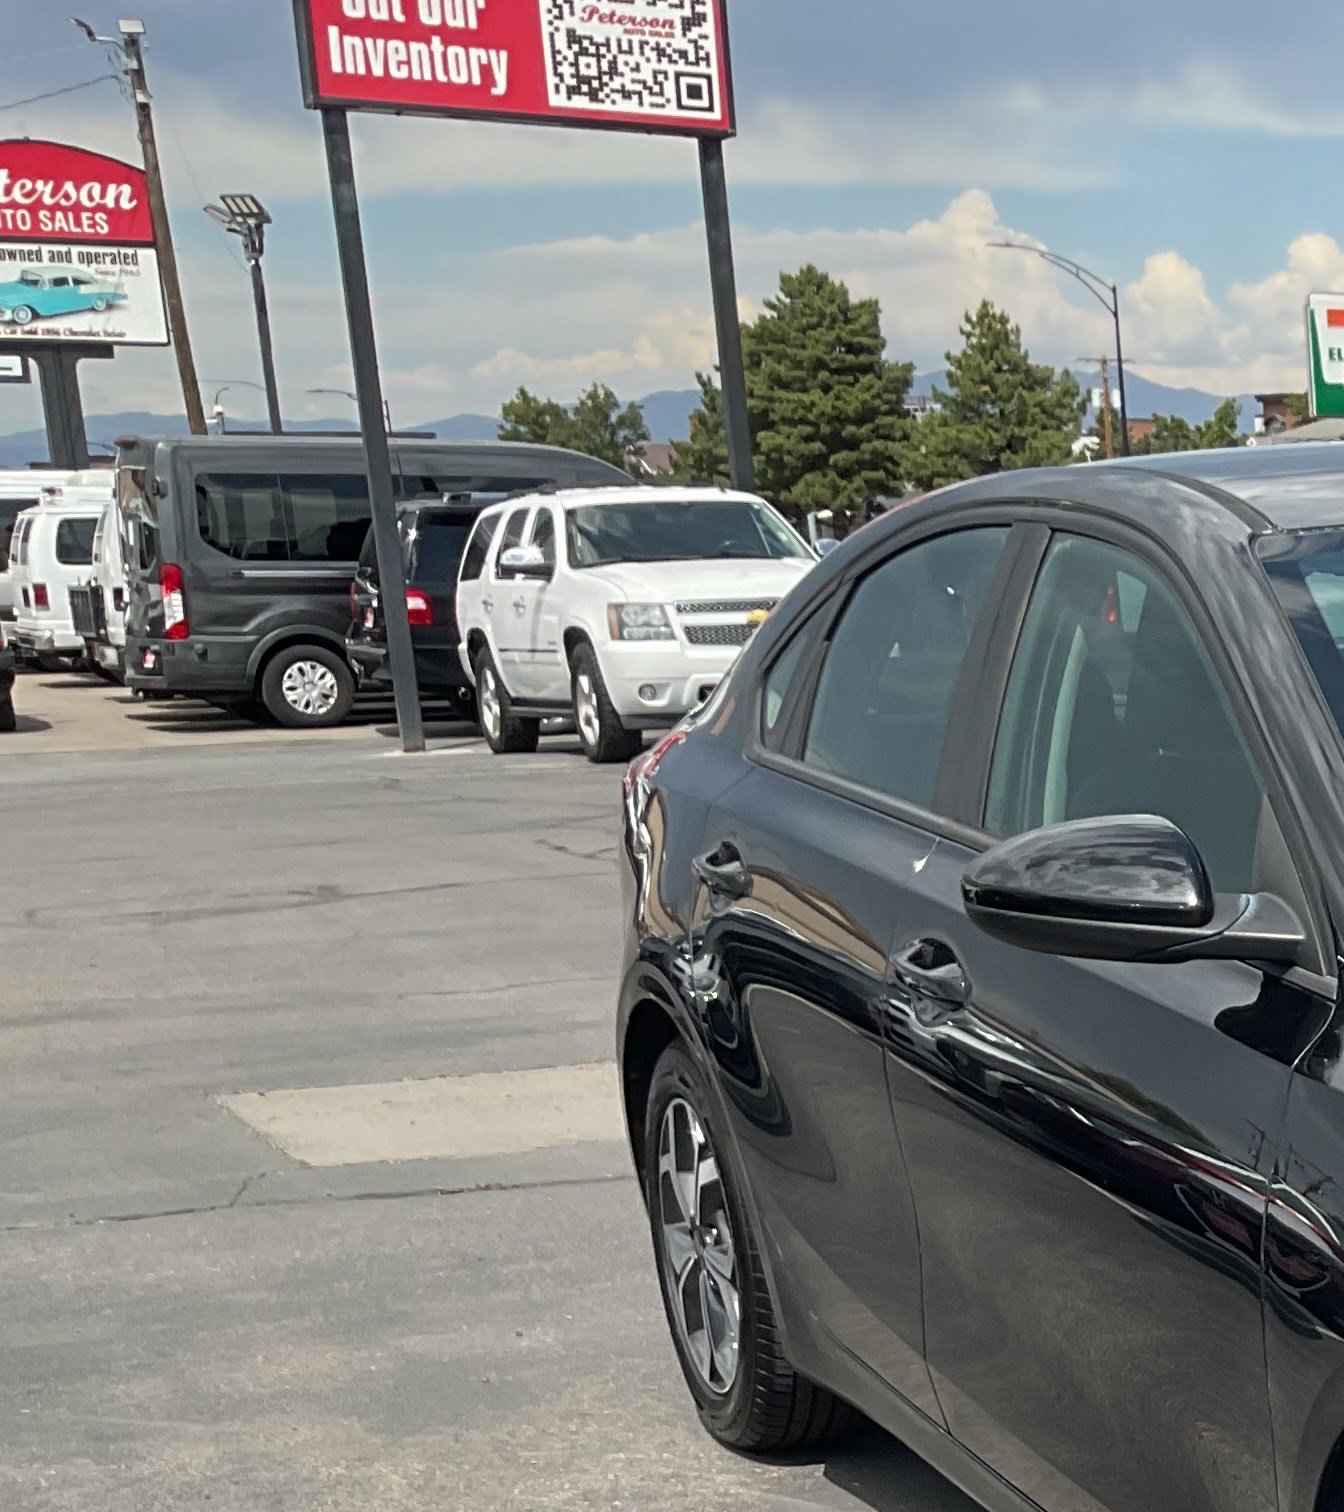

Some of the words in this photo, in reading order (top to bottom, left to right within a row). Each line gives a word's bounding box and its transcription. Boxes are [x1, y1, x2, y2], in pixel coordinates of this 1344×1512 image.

[579, 5, 677, 30] Peterson
[327, 25, 508, 96] Inventory
[0, 169, 138, 210] terson
[0, 209, 31, 231] TO
[38, 209, 109, 234] SALES
[47, 247, 73, 264] and
[78, 249, 140, 267] operated
